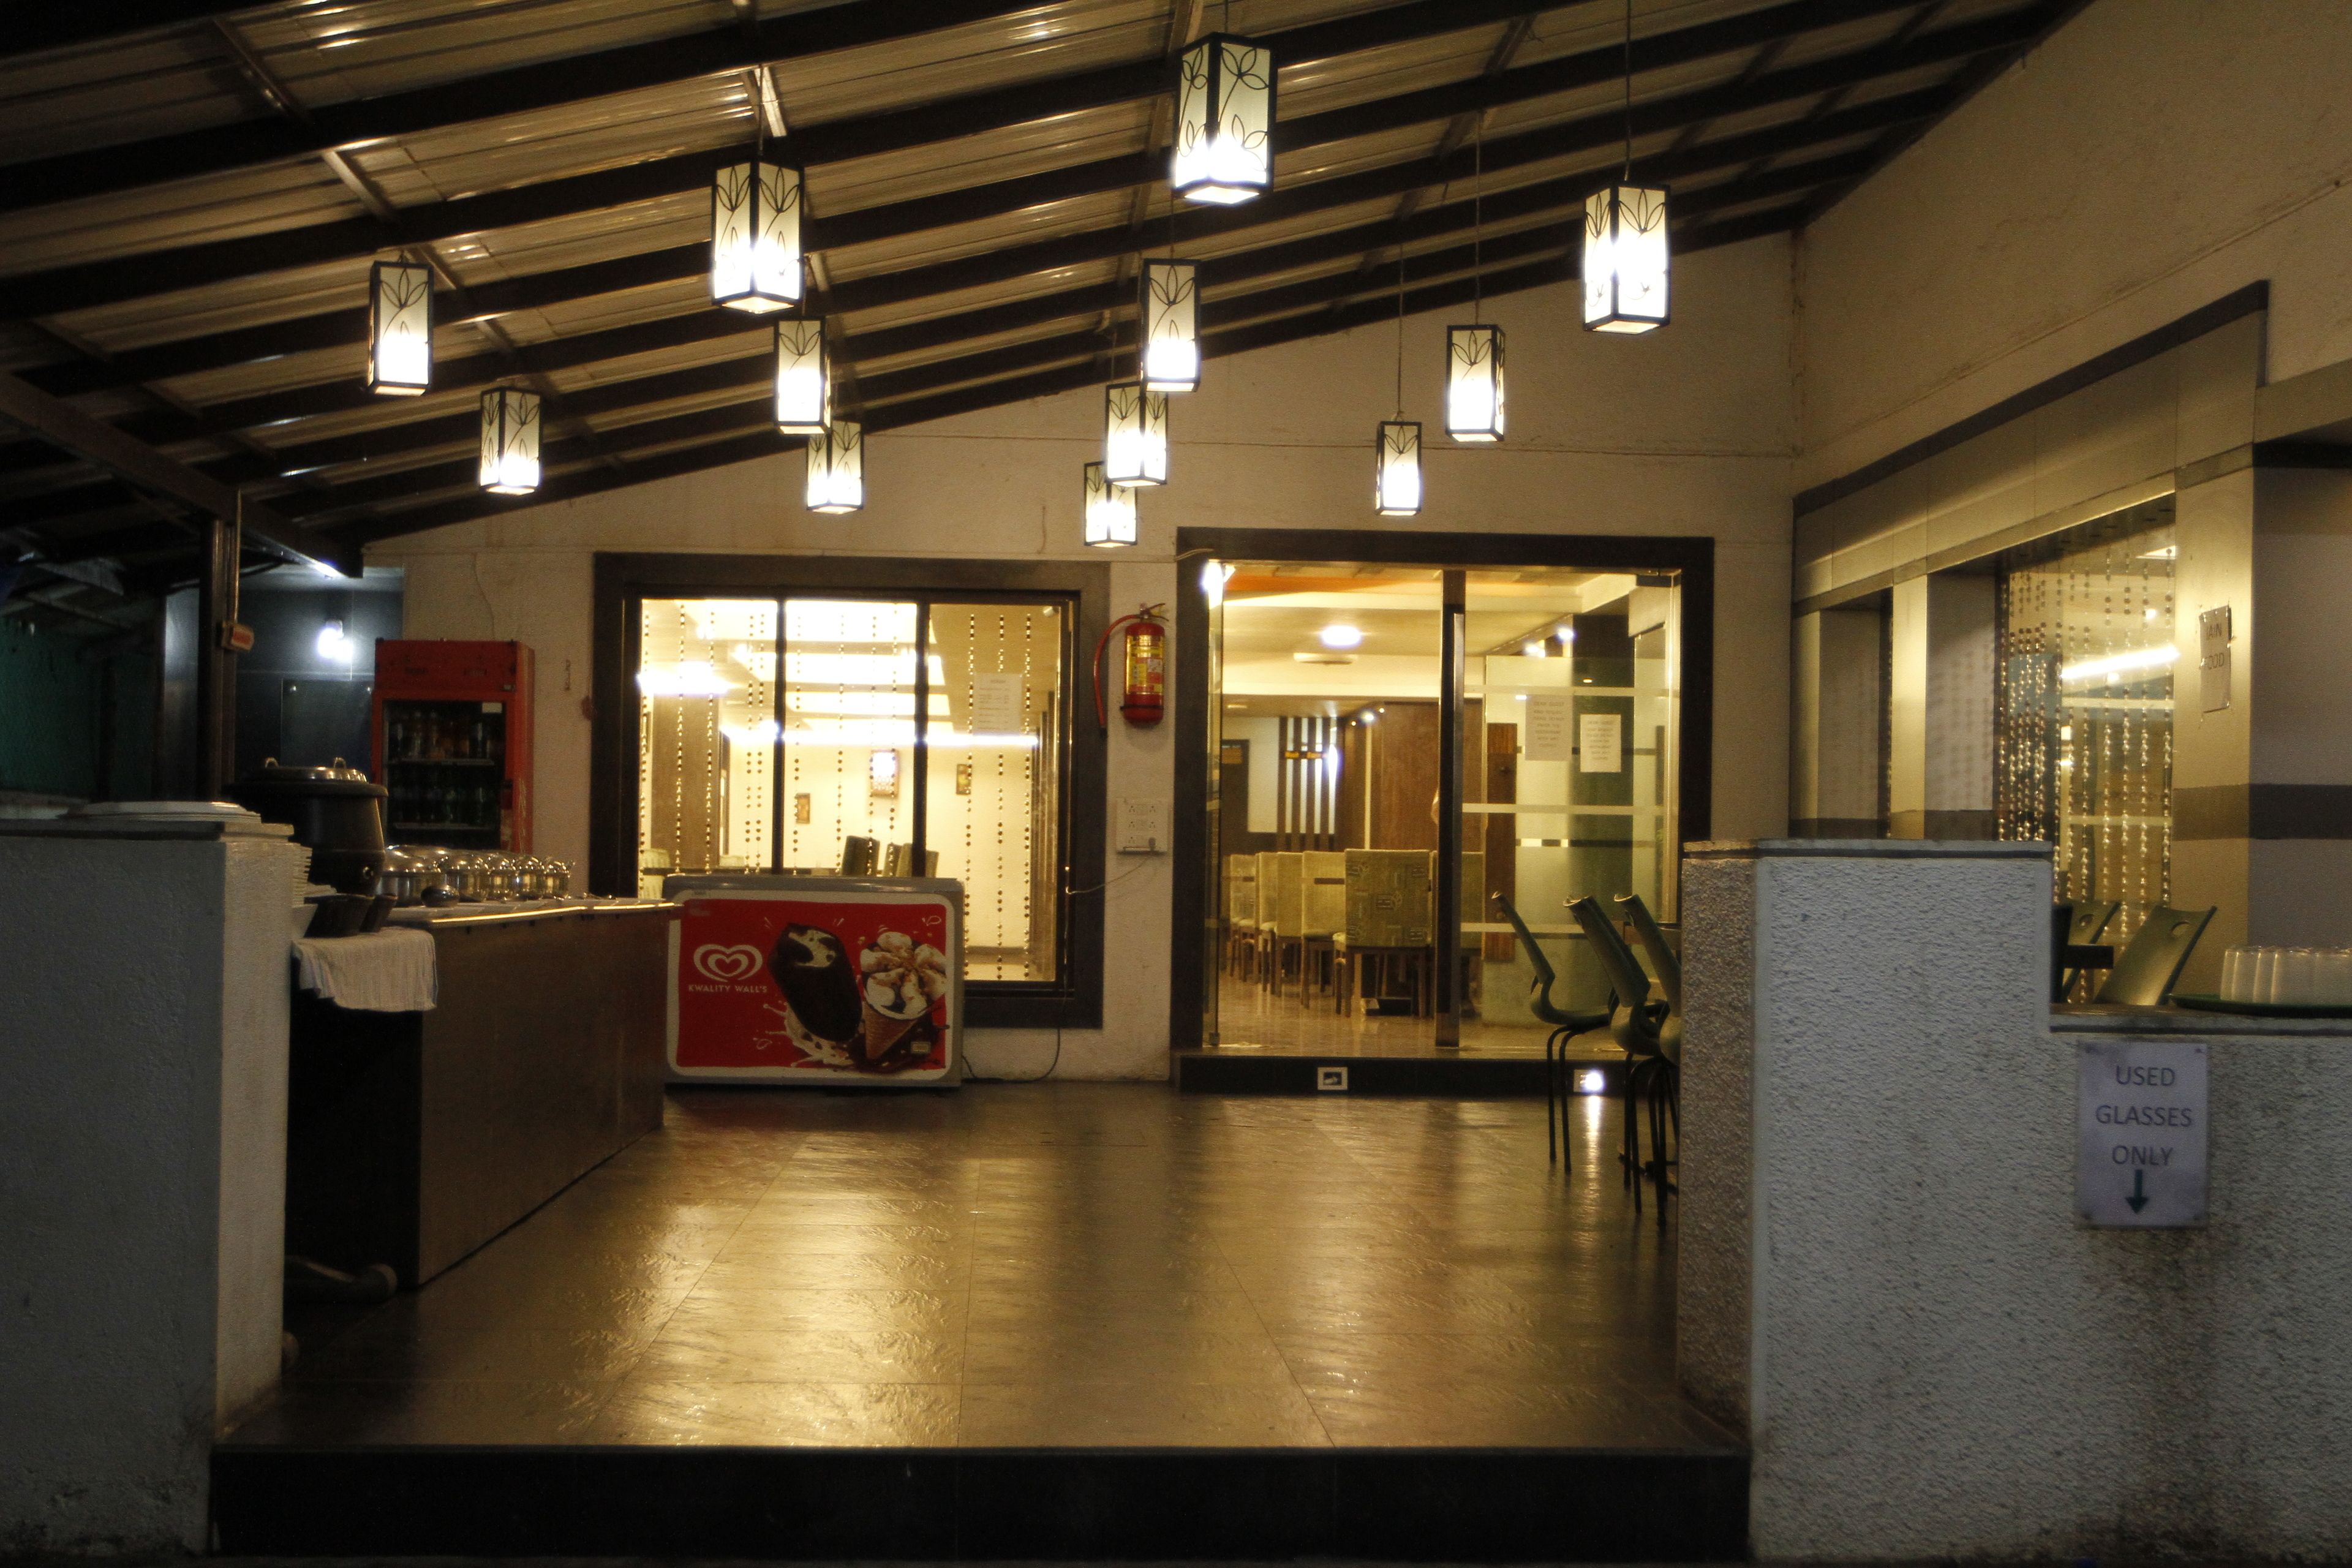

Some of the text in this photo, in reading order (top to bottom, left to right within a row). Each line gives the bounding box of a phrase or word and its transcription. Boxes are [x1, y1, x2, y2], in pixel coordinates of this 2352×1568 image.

[2115, 1066, 2176, 1087] USED
[2095, 1105, 2193, 1127] GLASSES
[2113, 1145, 2174, 1166] ONLY
